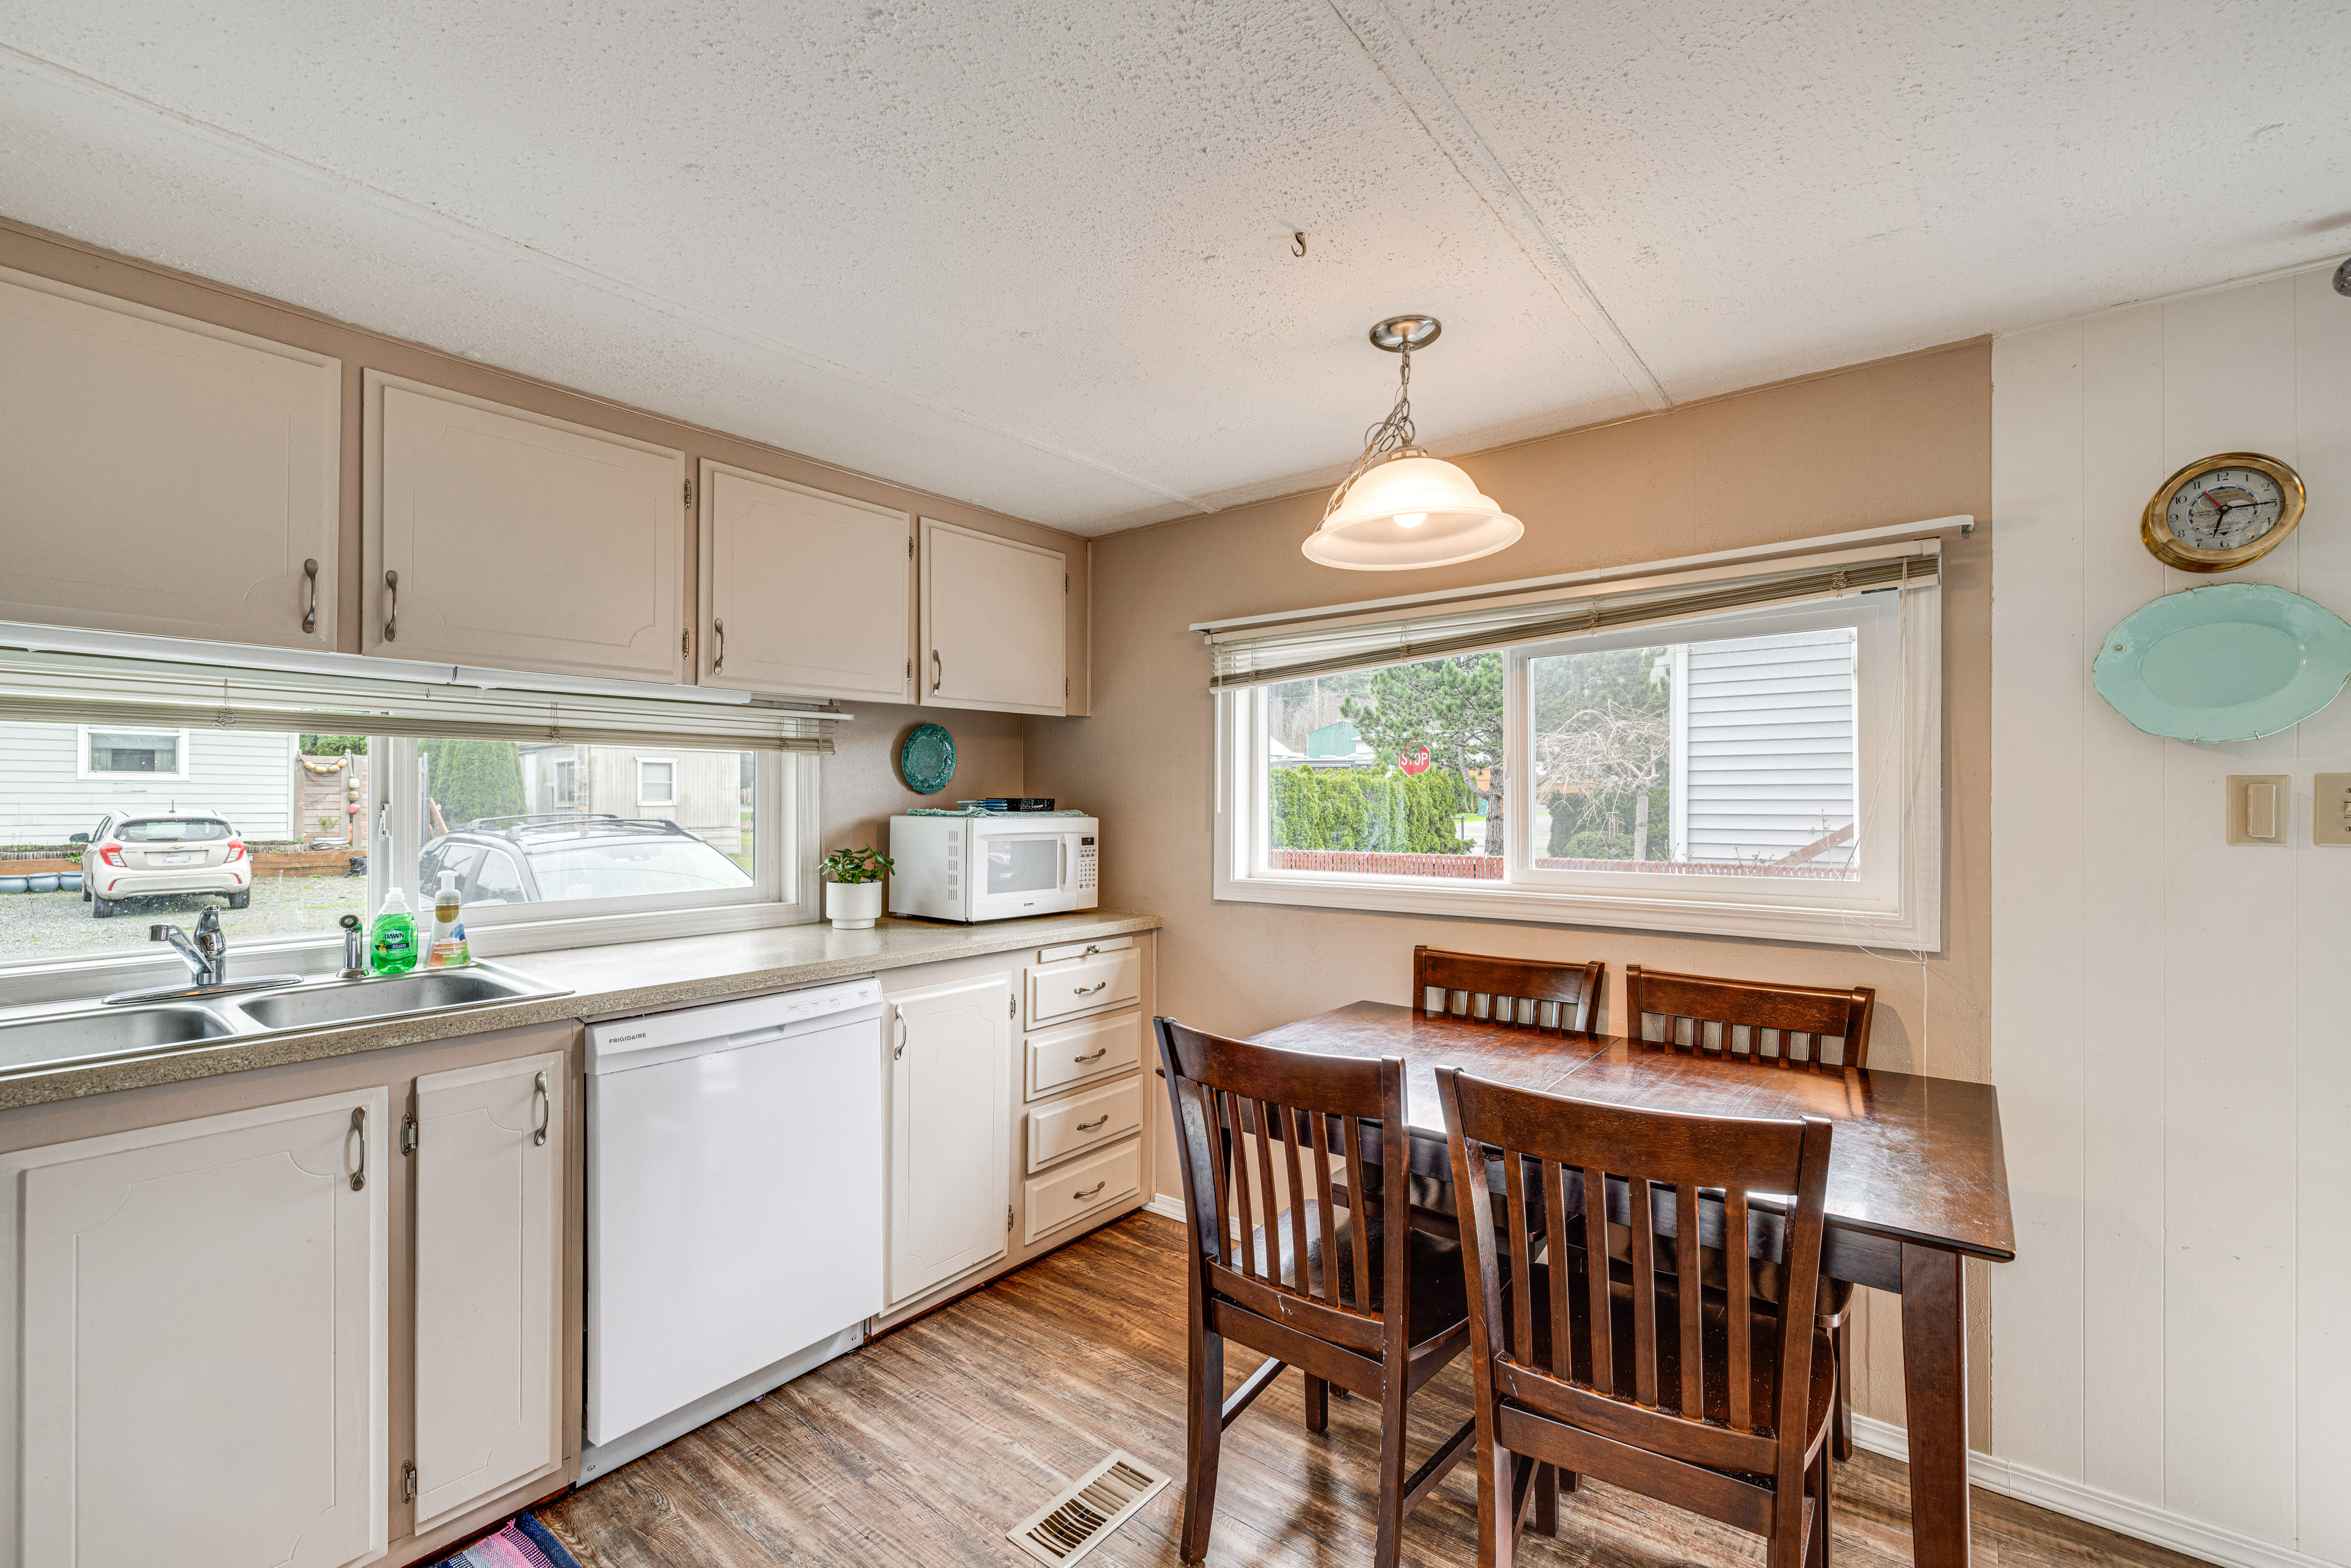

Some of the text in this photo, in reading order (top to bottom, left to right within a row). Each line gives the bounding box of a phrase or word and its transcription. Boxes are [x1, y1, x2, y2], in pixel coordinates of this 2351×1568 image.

[2216, 471, 2229, 481] 12
[2193, 481, 2200, 490] 11
[2261, 482, 2271, 491] 2
[2175, 495, 2188, 505] 10
[2170, 514, 2178, 522] 9
[2178, 529, 2185, 538] 8
[2247, 531, 2254, 540] 5
[2195, 539, 2203, 547] 7
[2220, 539, 2229, 548] 6
[1401, 752, 1428, 765] STOP
[609, 1032, 647, 1044] FRIGIDAIRE
